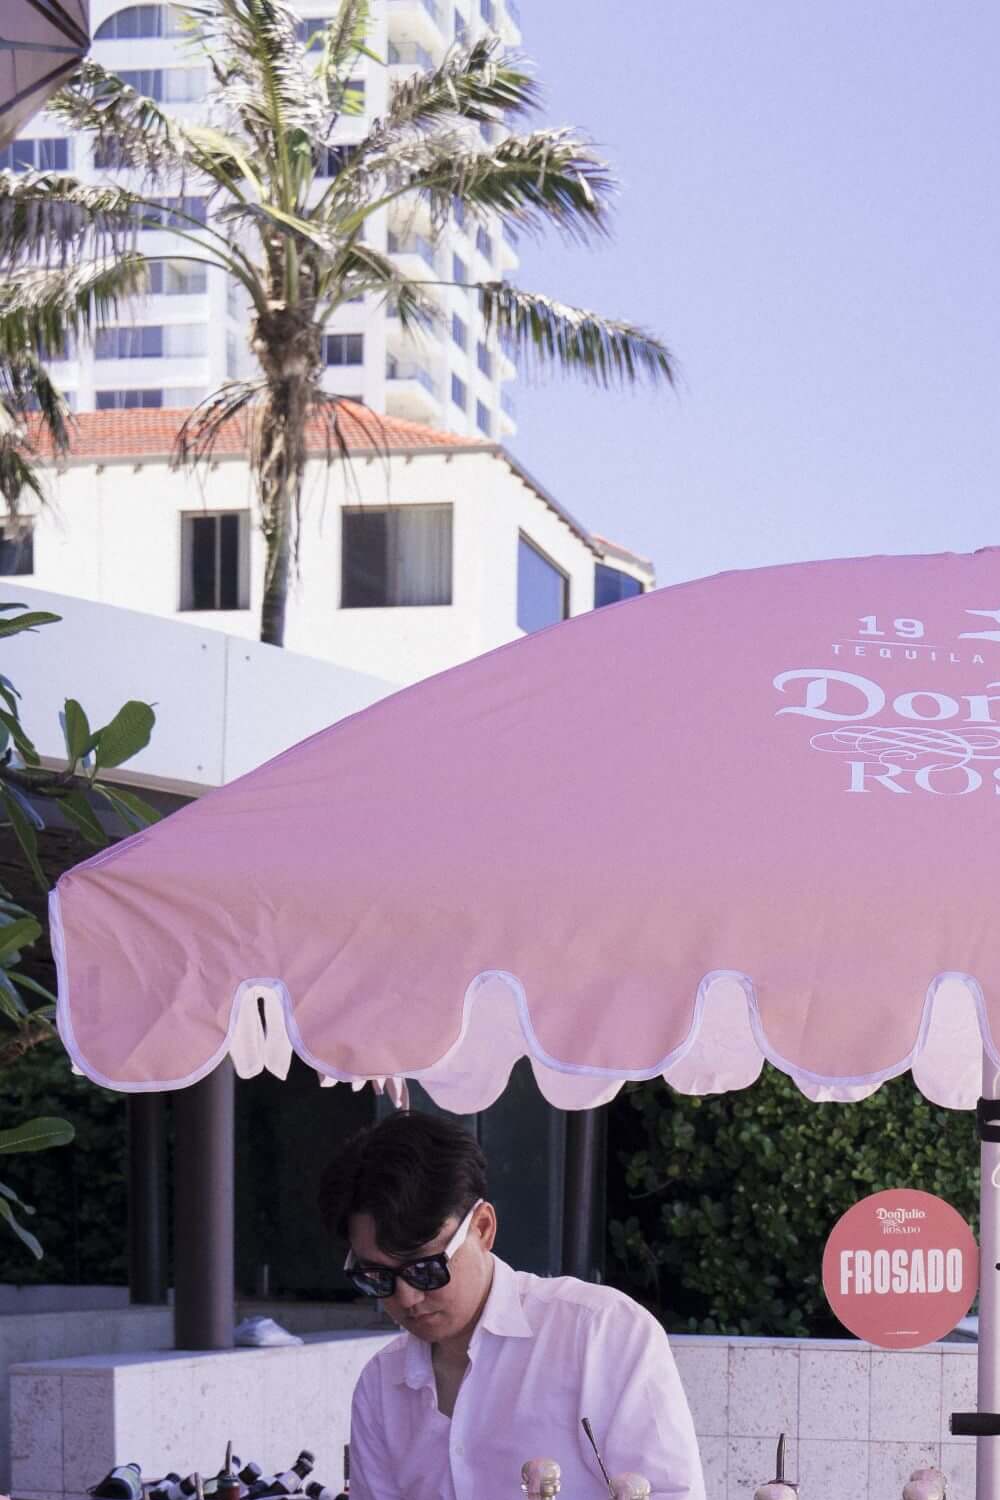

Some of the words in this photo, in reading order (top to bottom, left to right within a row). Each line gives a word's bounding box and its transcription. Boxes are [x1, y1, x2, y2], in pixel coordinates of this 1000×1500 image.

[856, 615, 925, 638] 19
[832, 644, 984, 664] TEQUILA
[882, 1225, 921, 1235] ROSADO
[840, 1247, 963, 1295] FROSADO
